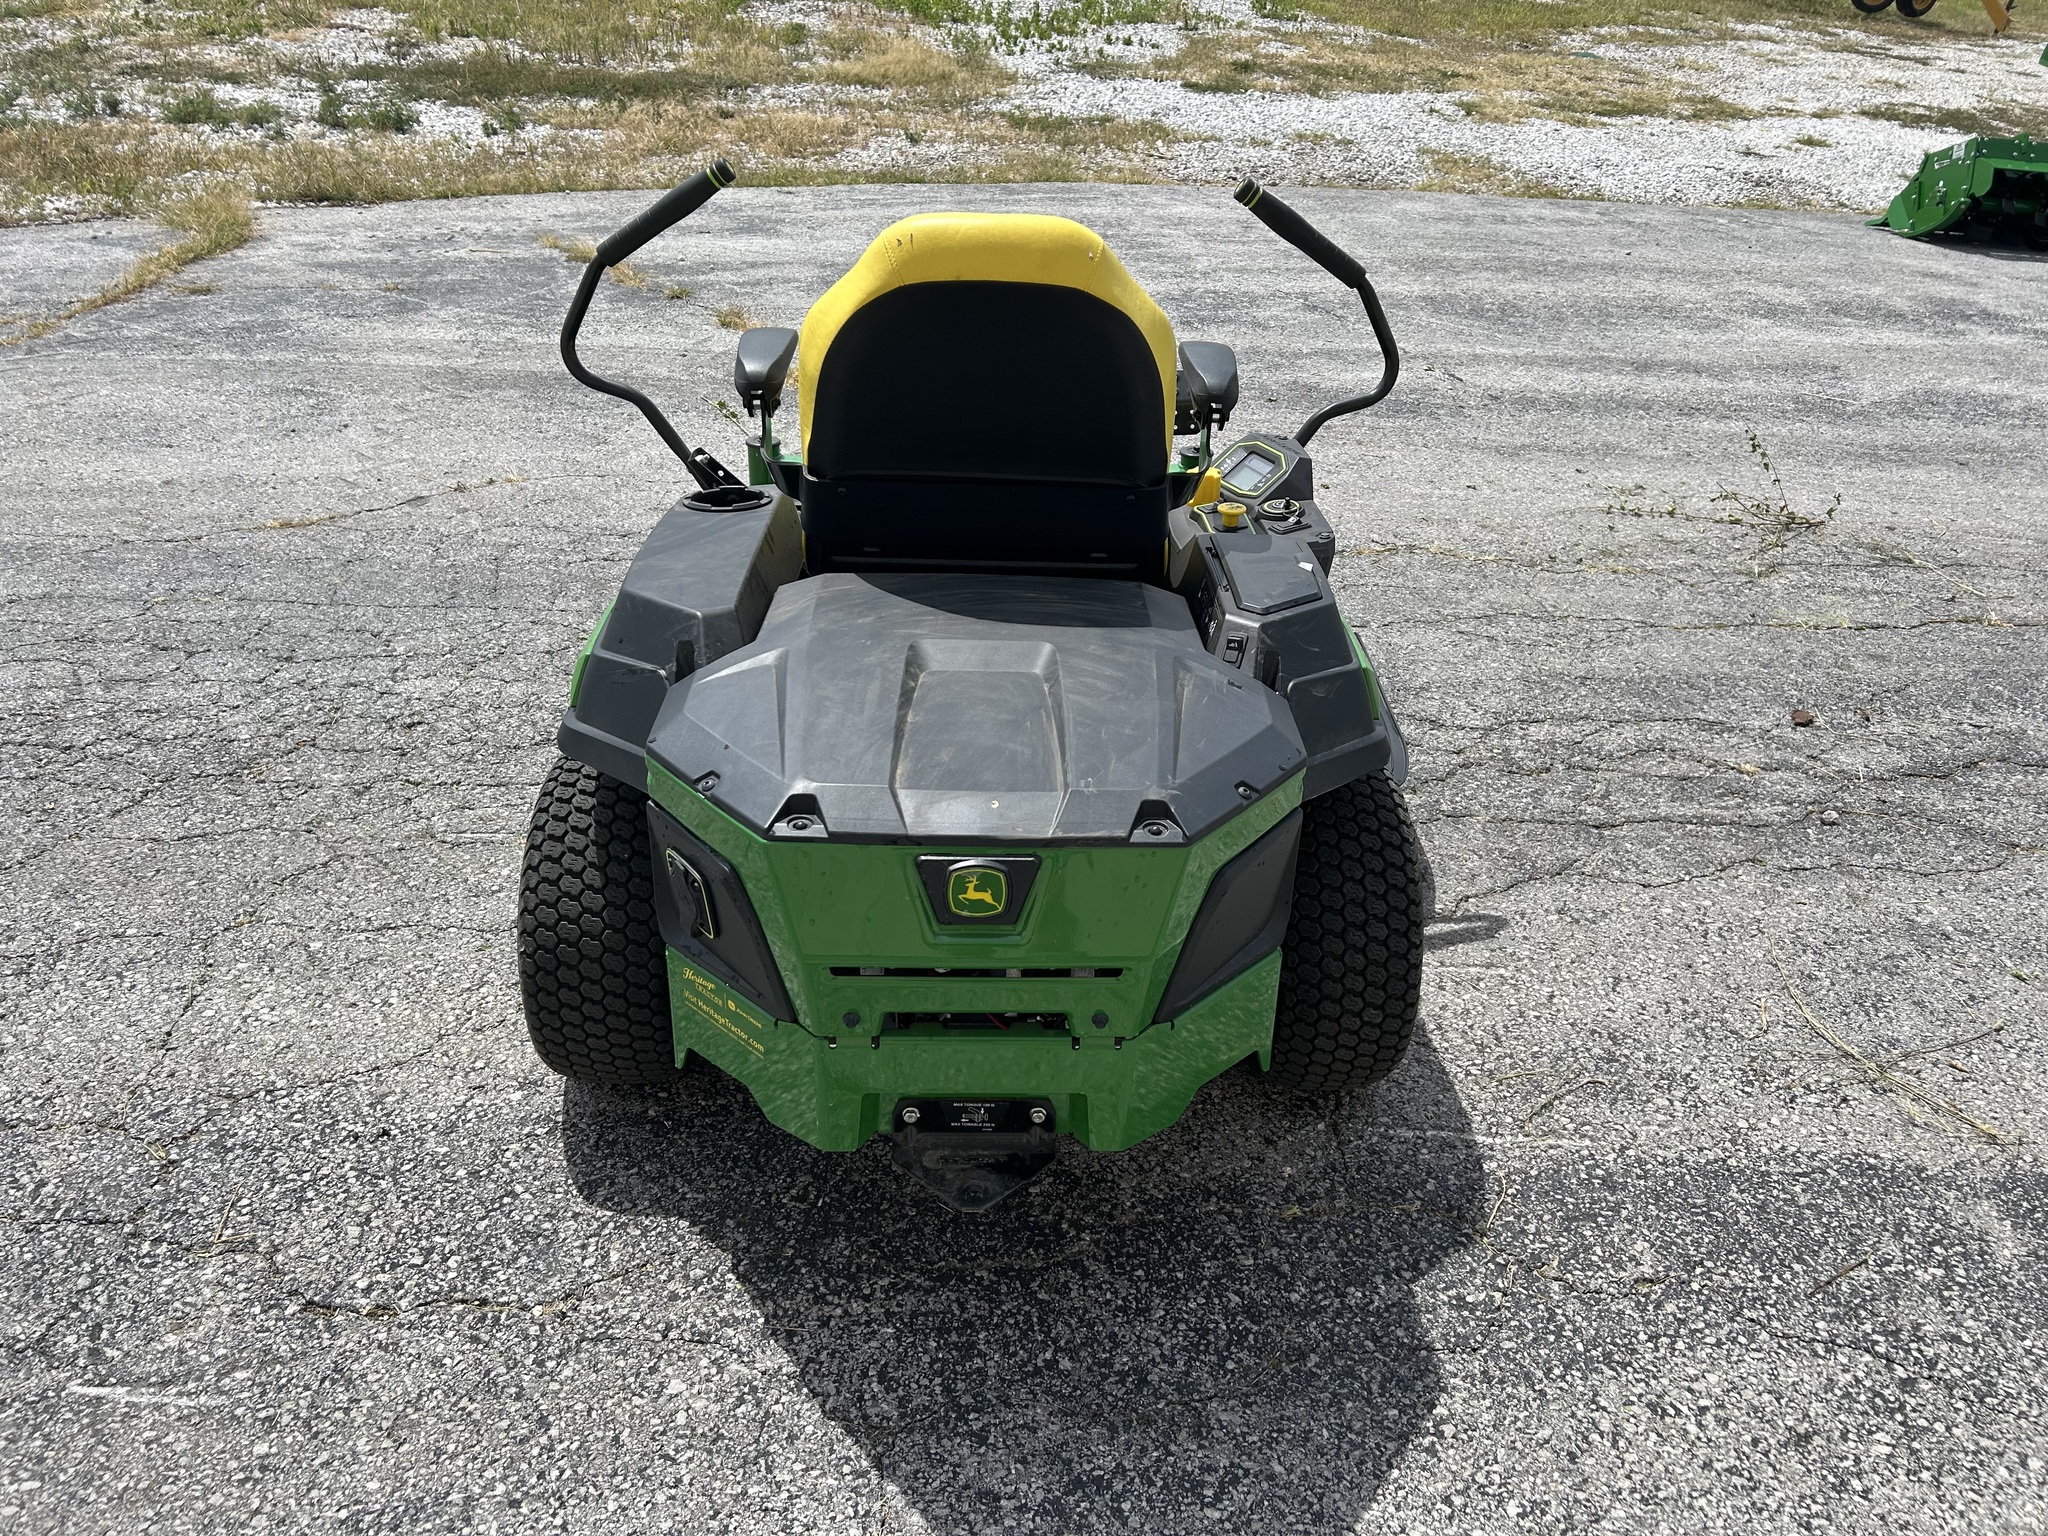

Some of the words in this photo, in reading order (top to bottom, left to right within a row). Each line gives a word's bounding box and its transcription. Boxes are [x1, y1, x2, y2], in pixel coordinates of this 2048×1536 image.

[683, 967, 716, 990] Heritage
[683, 988, 698, 1005] Visit
[698, 998, 764, 1053] HeritageTractor.com
